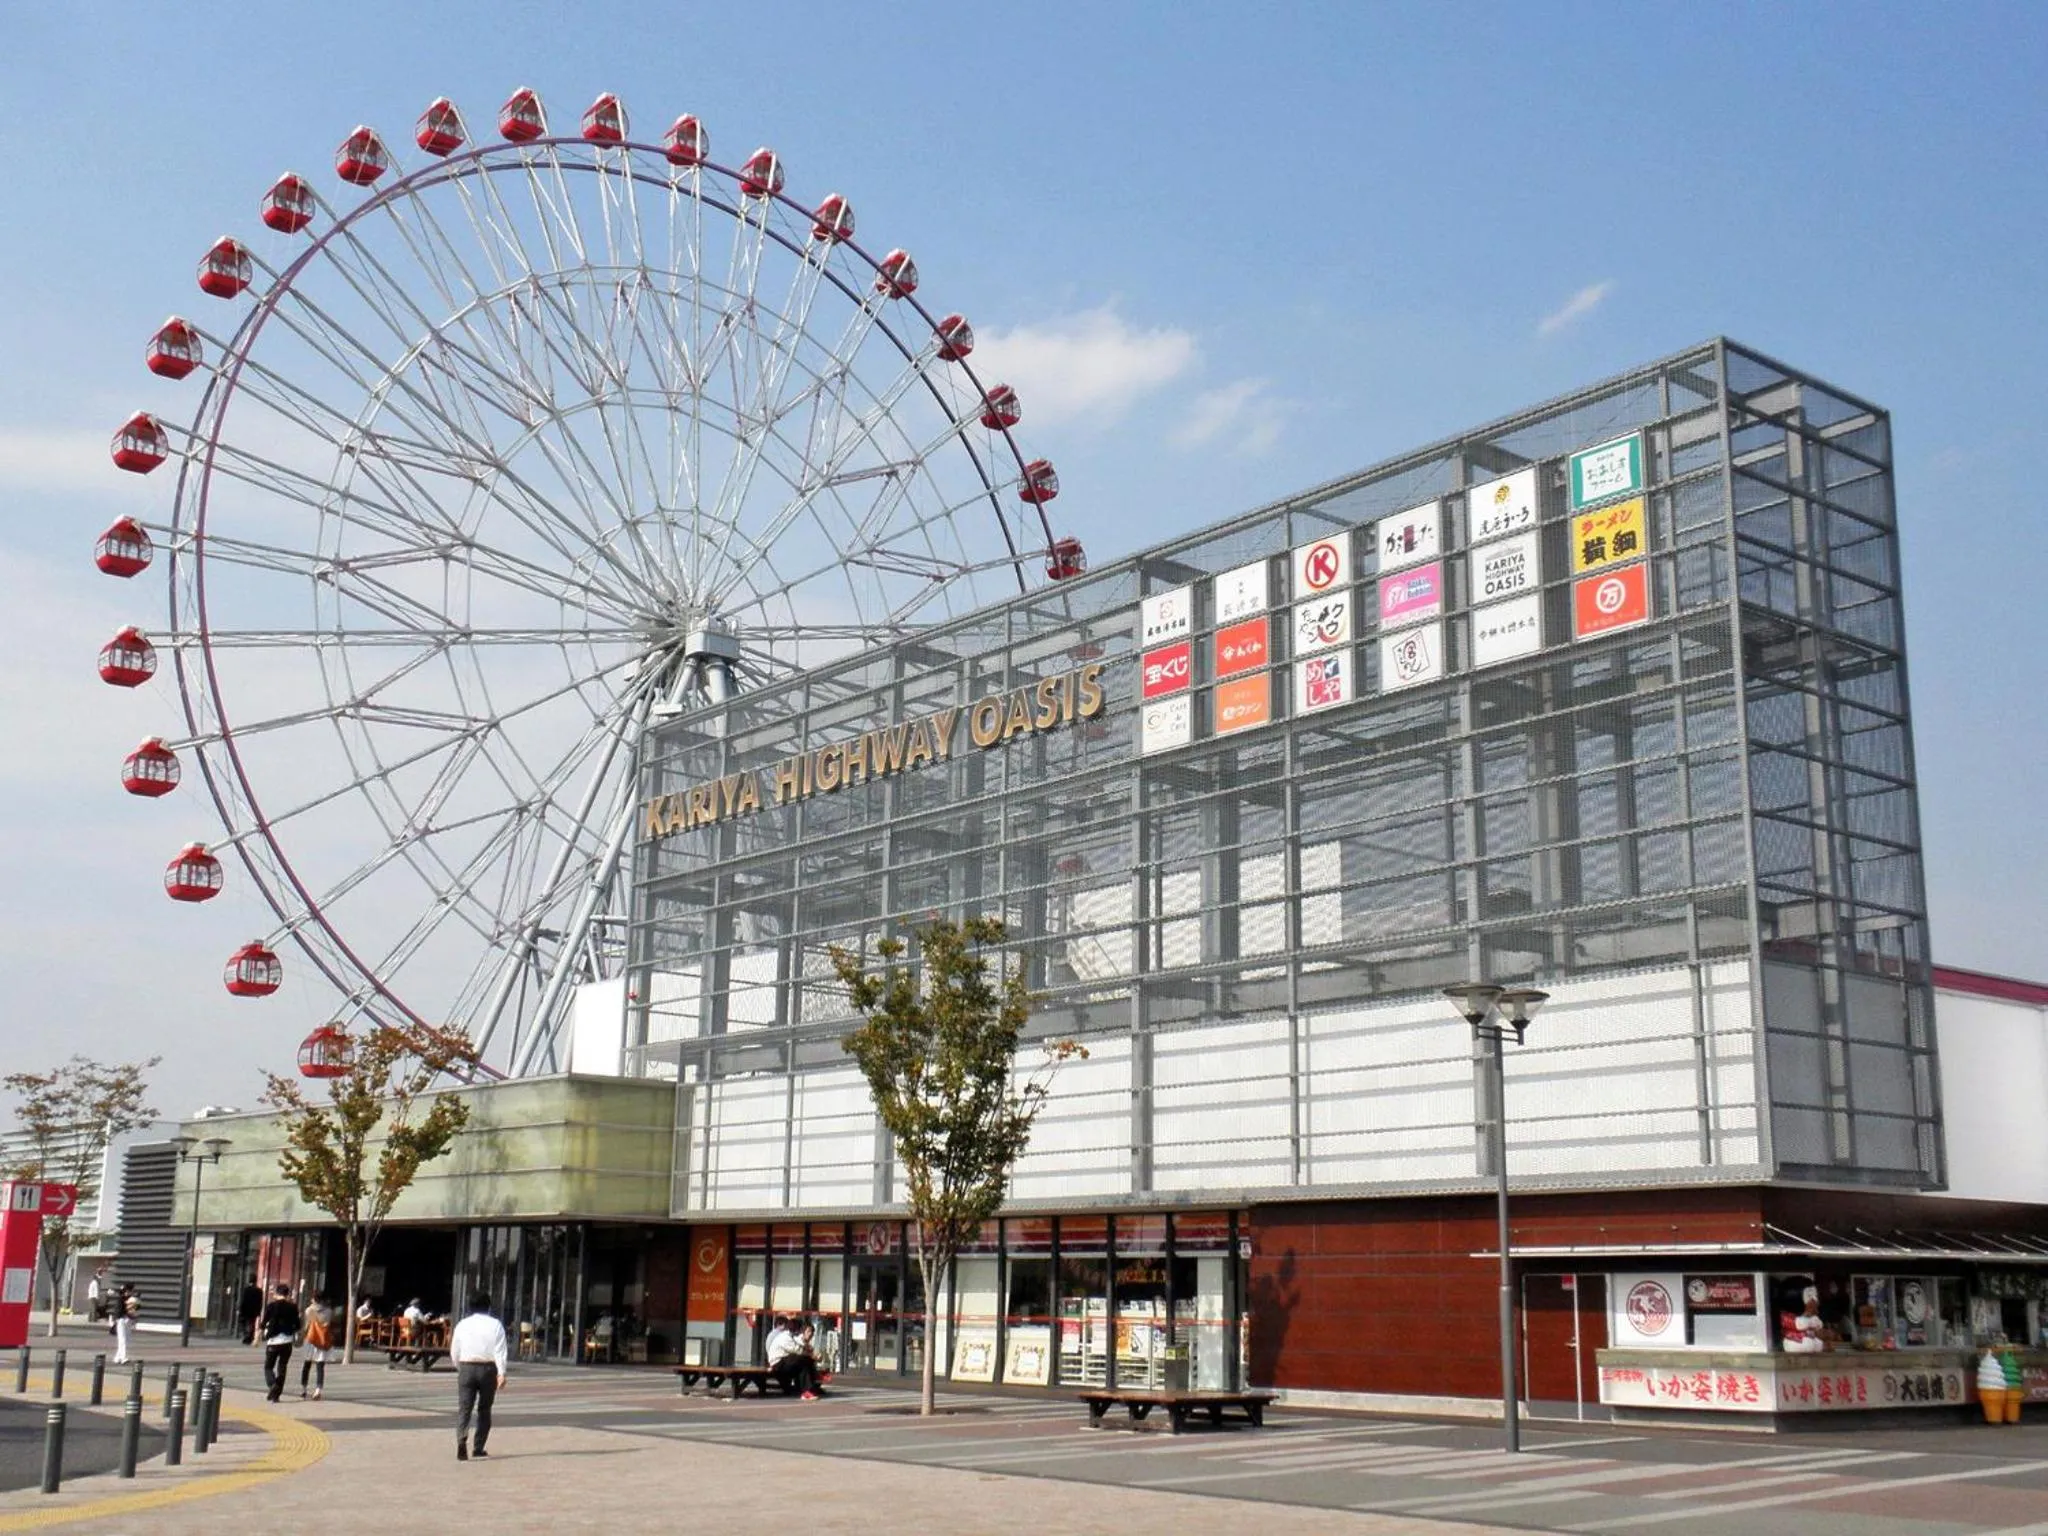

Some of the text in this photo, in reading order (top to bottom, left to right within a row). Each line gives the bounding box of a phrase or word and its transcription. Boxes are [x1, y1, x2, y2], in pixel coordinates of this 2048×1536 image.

[1582, 509, 1633, 537] ラーメン
[1311, 549, 1336, 584] K
[1485, 553, 1525, 572] KARIYA
[1485, 573, 1525, 594] OASIS
[1145, 656, 1188, 687] 宝くじ
[646, 663, 1103, 838] KARIYA HIGHWAY OASIS
[1646, 1373, 1760, 1402] いか姿焼き
[1782, 1376, 1867, 1403] いか姿焼き
